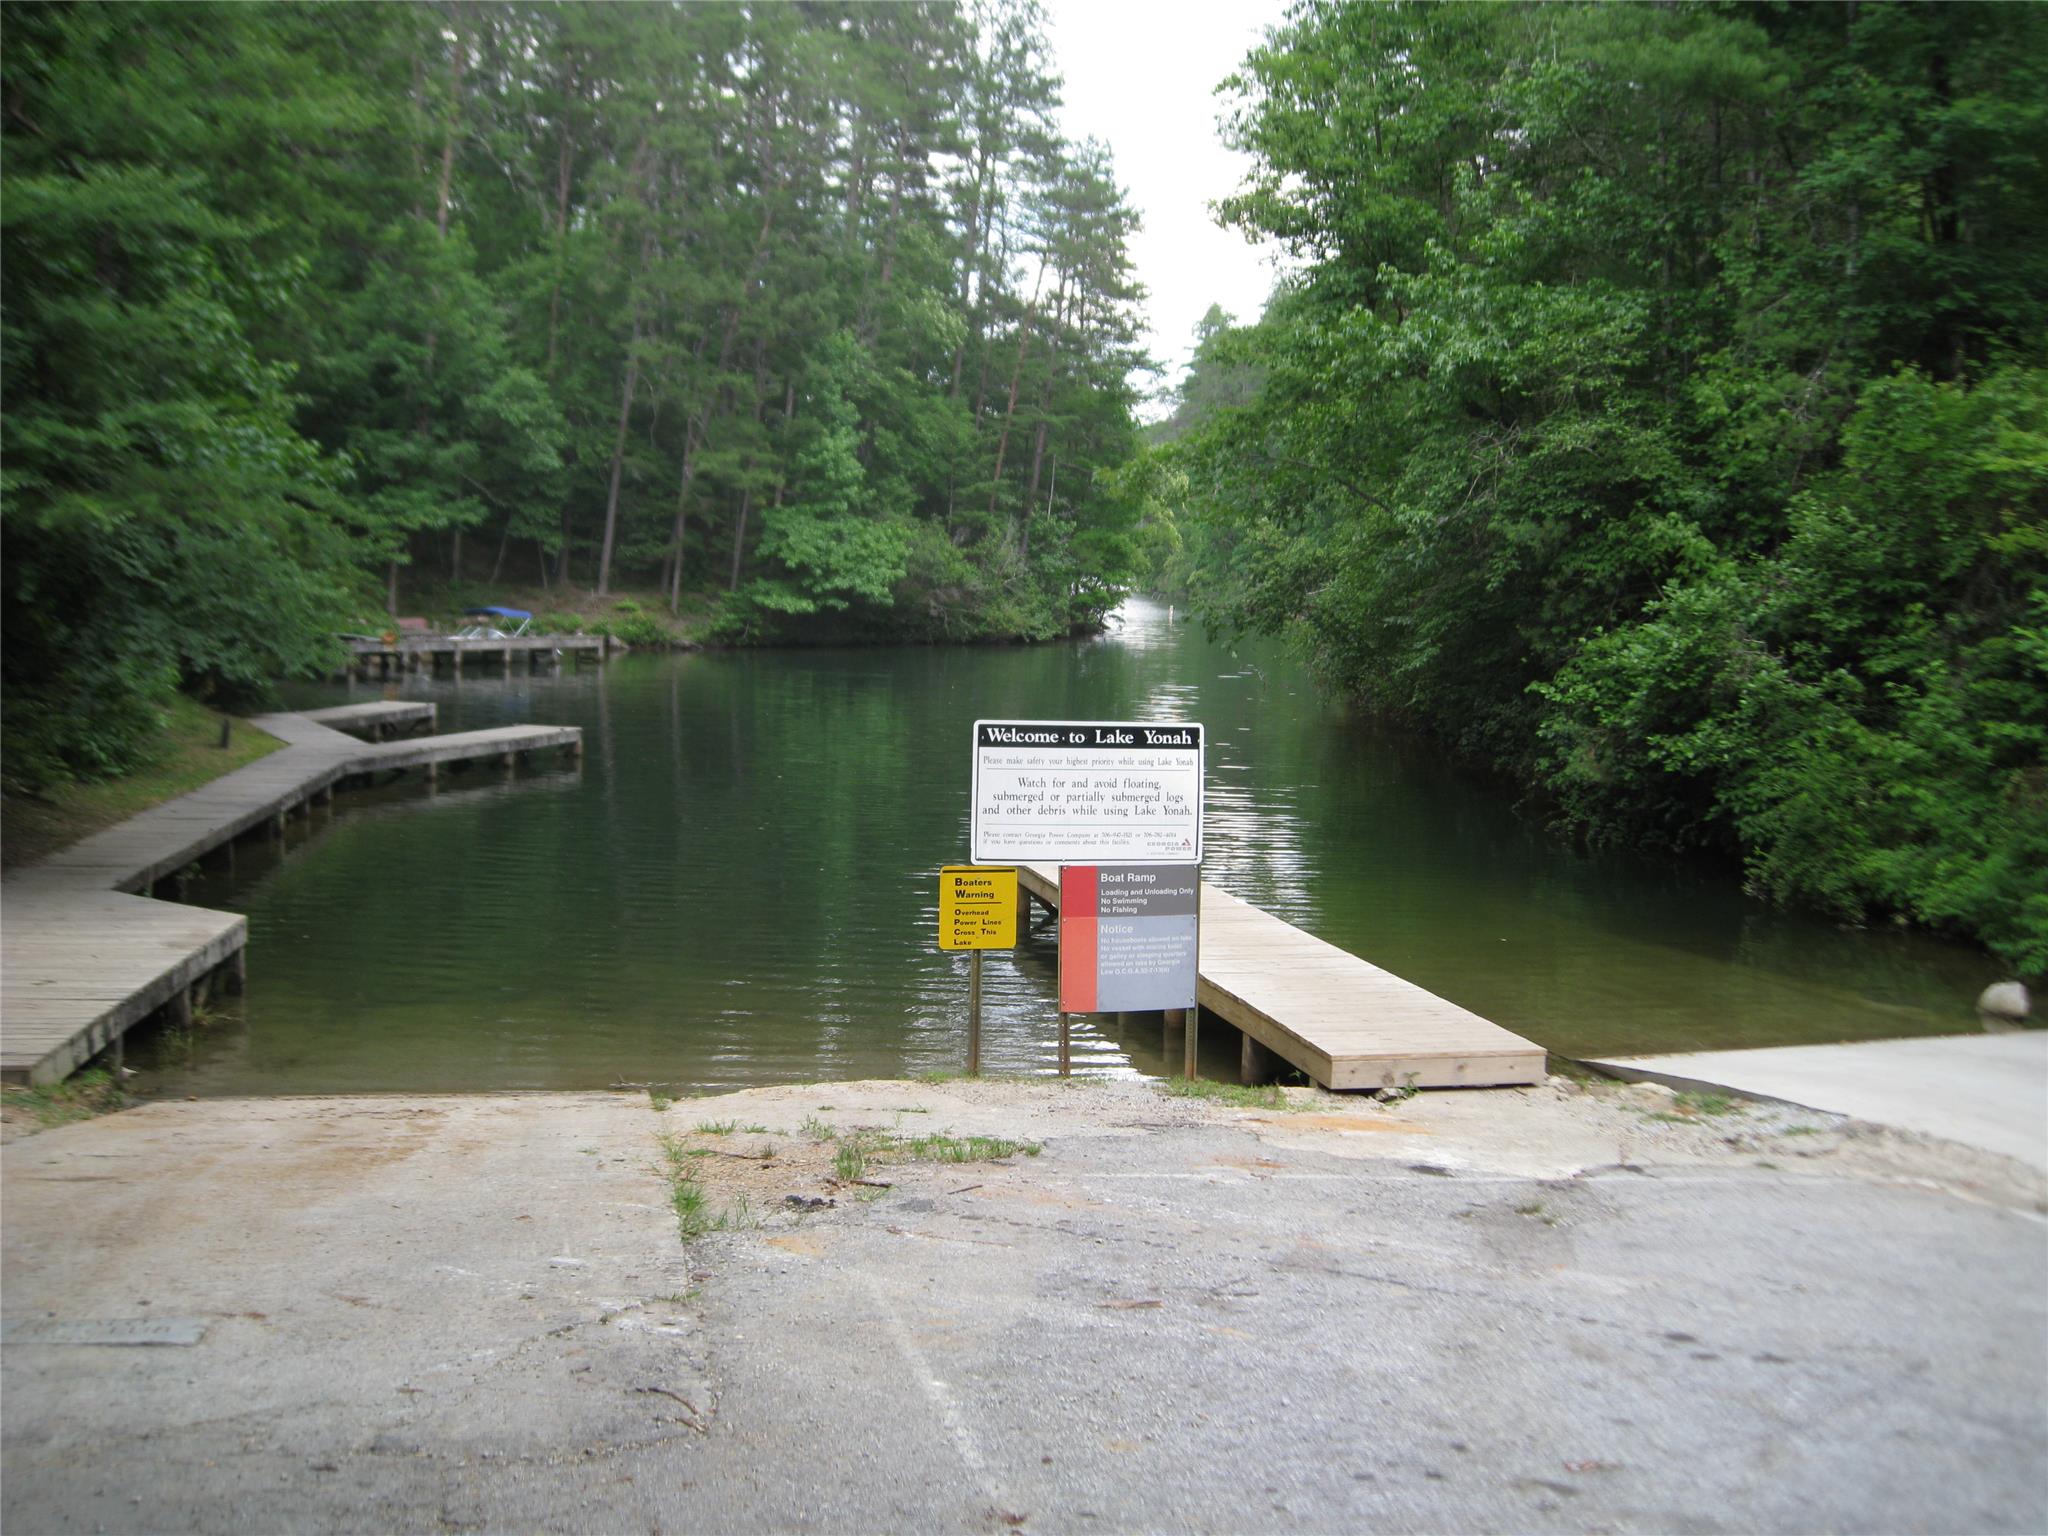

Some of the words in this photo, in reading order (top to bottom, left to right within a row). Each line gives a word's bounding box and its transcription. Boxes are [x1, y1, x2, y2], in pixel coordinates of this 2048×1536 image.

[986, 727, 1059, 743] Welcome
[1069, 731, 1085, 743] to
[1095, 729, 1134, 744] Lake
[1143, 729, 1193, 745] Yonah
[983, 755, 1002, 765] Please
[1007, 756, 1023, 765] make
[1027, 755, 1045, 767] safety
[1049, 758, 1063, 767] your
[1067, 756, 1088, 767] highest
[1091, 756, 1114, 767] priority
[1118, 756, 1135, 766] while
[1138, 757, 1154, 767] using
[1157, 757, 1173, 766] Lake
[1176, 757, 1194, 766] Yonah
[1018, 777, 1047, 789] Watch
[1052, 777, 1066, 788] for
[1071, 777, 1088, 789] and
[1094, 778, 1118, 789] avoid
[992, 790, 1044, 803] submerged
[1050, 793, 1060, 801] or
[1066, 791, 1105, 804] partially
[1111, 791, 1161, 804] submerged
[1166, 791, 1184, 804] logs
[982, 804, 1000, 815] and
[1006, 804, 1032, 815] other
[1037, 804, 1067, 816] debris
[1072, 805, 1098, 816] while
[1103, 805, 1129, 817] using
[1134, 805, 1157, 816] Lake
[1163, 804, 1193, 816] Yonah.
[1024, 831, 1046, 840] Georgia
[954, 877, 992, 887] Boaters
[1100, 872, 1125, 883] Boat
[1127, 872, 1157, 884] Ramp
[954, 889, 995, 900] Warning
[1100, 889, 1129, 897] Loading
[1130, 888, 1143, 896] and
[1144, 887, 1178, 896] Unloading
[1178, 887, 1195, 896] Only
[1100, 897, 1111, 905] No
[1112, 896, 1148, 906] Swimming
[954, 908, 989, 916] Overhead
[1112, 906, 1138, 914] Fishing
[953, 918, 977, 926] Power
[982, 918, 1002, 926] Lines
[953, 928, 976, 936] Cross
[980, 928, 997, 936] This
[1100, 924, 1134, 934] Notice
[953, 938, 972, 946] Lake
